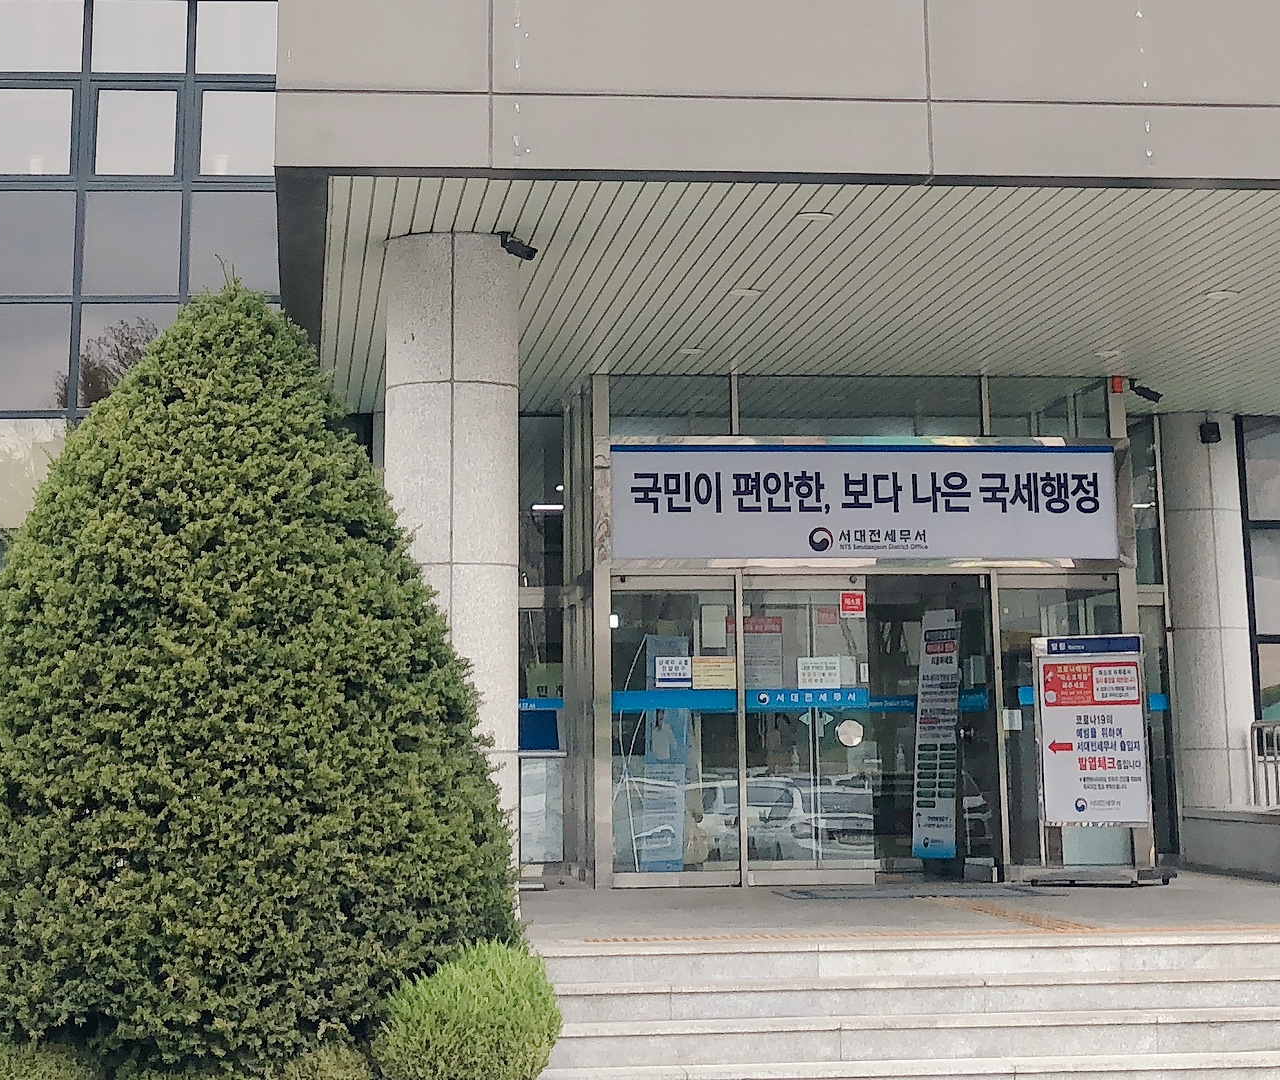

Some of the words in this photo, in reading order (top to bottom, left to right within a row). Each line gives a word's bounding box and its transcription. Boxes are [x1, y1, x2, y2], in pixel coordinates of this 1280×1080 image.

[631, 471, 722, 513] 국민이
[732, 471, 831, 514] 편안한,
[841, 472, 902, 513] 보다
[911, 472, 972, 513] 나은
[979, 472, 1100, 514] 국세행정
[838, 529, 927, 542] 서대전세무서
[776, 692, 856, 703] 서대전세무서
